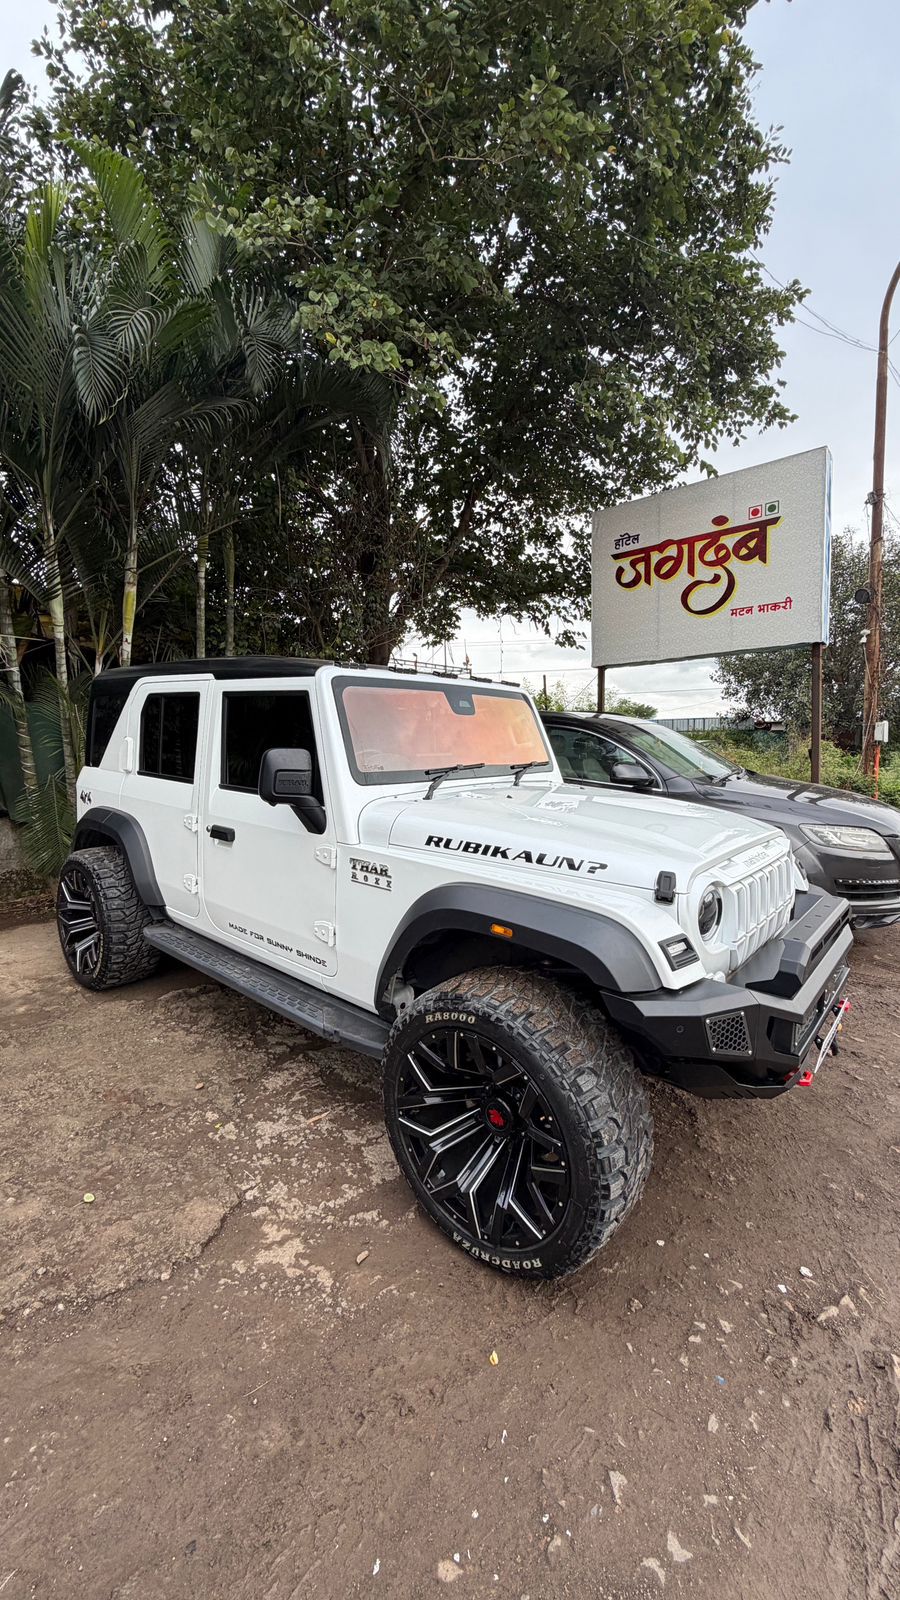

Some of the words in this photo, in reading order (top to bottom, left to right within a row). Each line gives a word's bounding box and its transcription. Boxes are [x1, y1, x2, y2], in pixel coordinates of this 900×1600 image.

[614, 532, 640, 550] हॉटेल
[611, 515, 782, 616] जगदंब
[730, 606, 754, 617] मटन
[757, 596, 793, 613] भाकरी
[349, 857, 392, 879] THAR
[424, 835, 609, 875] RUBIKAUN?
[228, 922, 248, 935] MADE
[249, 930, 265, 942] FOR
[266, 937, 293, 953] SUNNY
[295, 949, 328, 968] SHINDE
[425, 1011, 476, 1025] RA8000
[452, 1231, 542, 1270] ROADCRUZA
